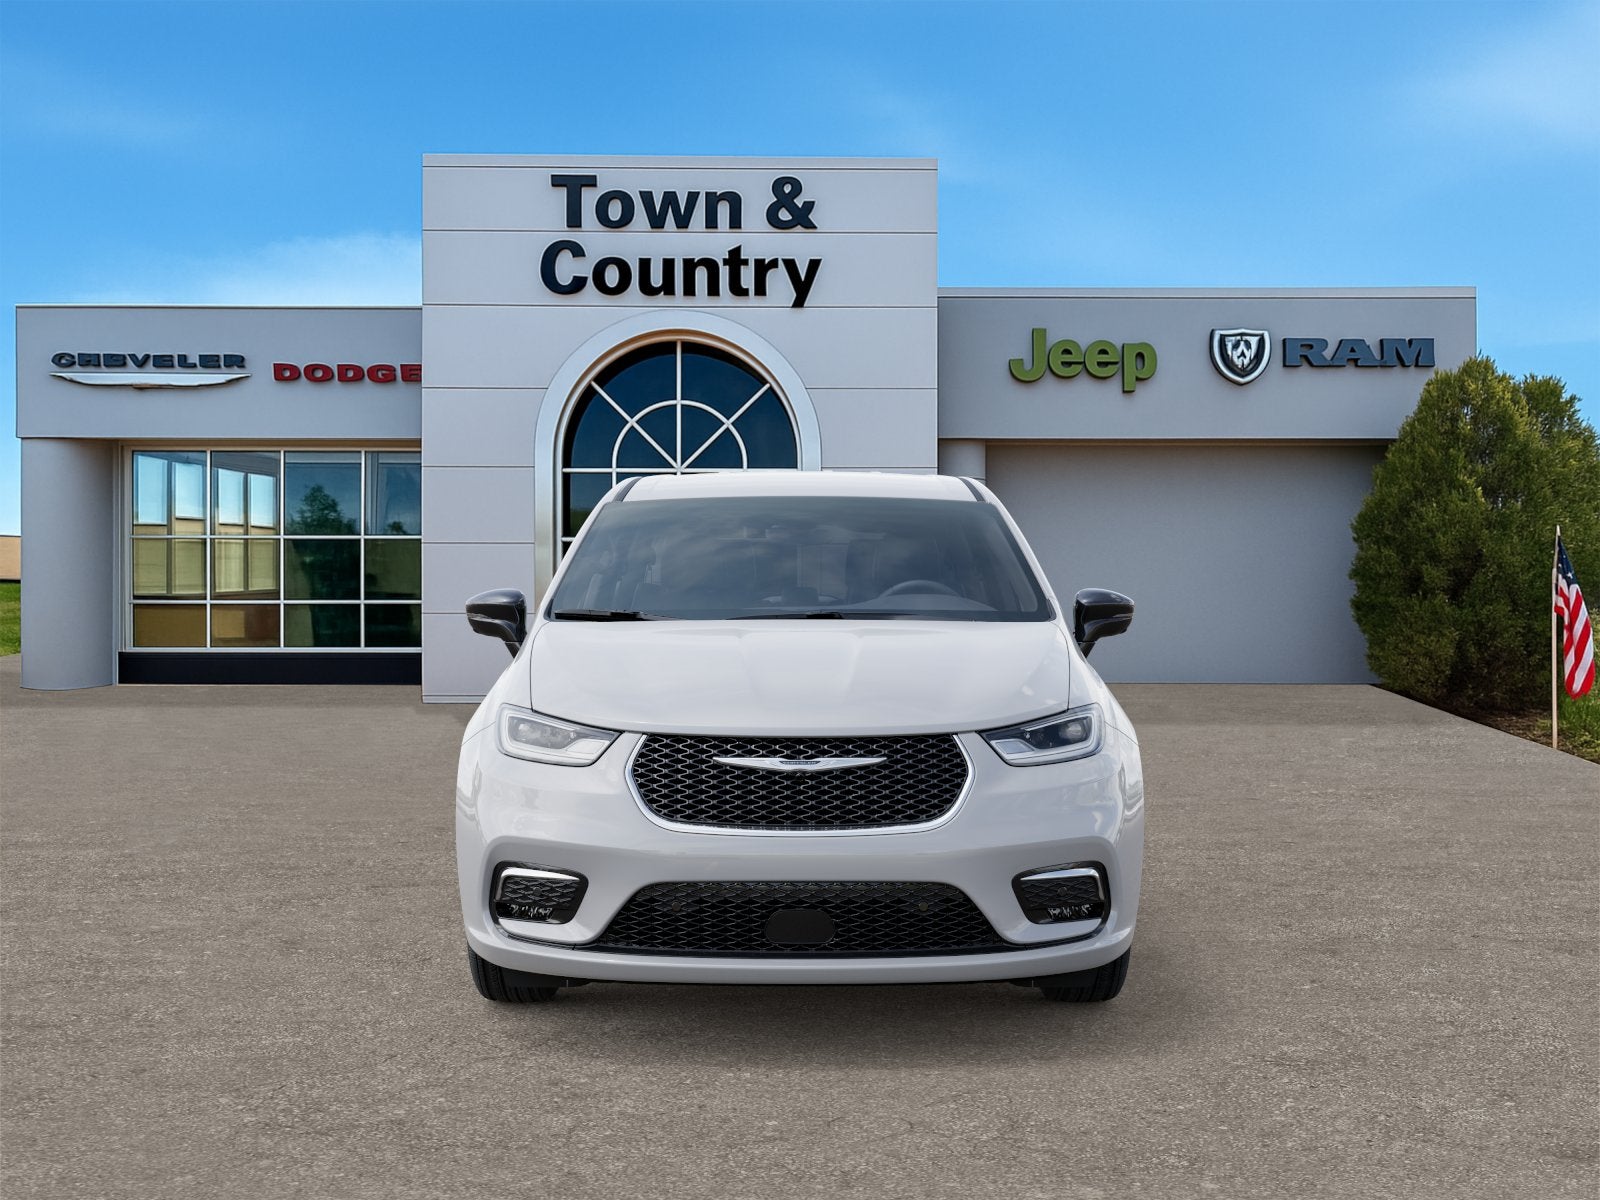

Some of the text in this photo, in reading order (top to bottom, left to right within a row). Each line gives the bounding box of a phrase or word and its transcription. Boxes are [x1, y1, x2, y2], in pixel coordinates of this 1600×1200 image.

[550, 174, 818, 230] Town &
[540, 239, 822, 308] Country
[273, 363, 422, 383] DODGE
[1008, 328, 1158, 393] Jeep
[1282, 338, 1436, 368] RAM
